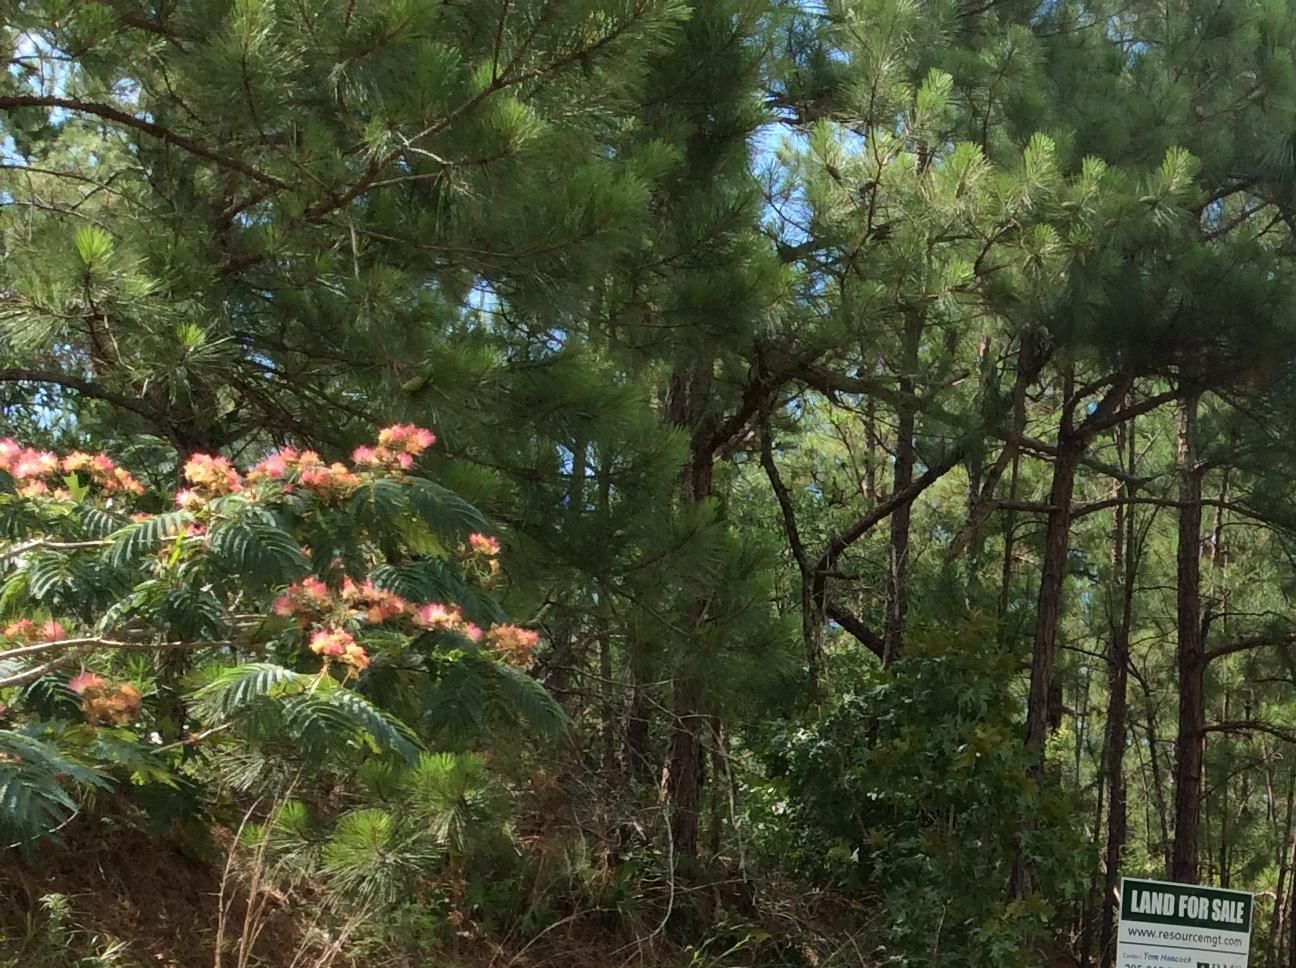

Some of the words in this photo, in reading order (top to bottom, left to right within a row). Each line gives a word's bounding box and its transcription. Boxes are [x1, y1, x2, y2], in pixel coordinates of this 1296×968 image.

[1131, 890, 1175, 916] LAND
[1179, 895, 1209, 919] FOR
[1211, 899, 1245, 924] SALE
[1128, 927, 1242, 947] www.resourcemgt.com
